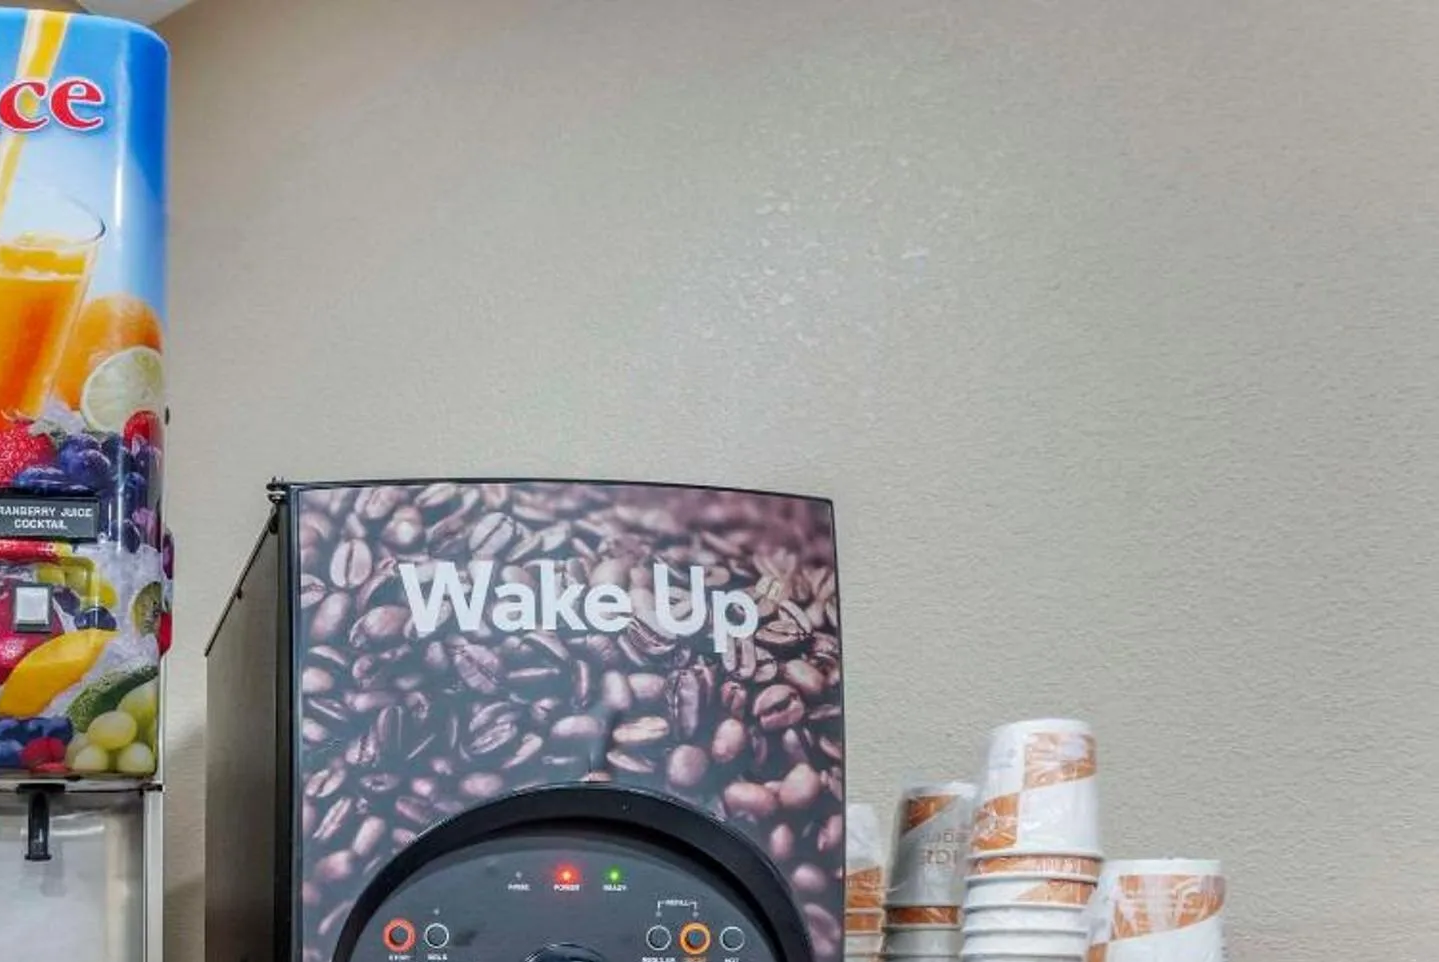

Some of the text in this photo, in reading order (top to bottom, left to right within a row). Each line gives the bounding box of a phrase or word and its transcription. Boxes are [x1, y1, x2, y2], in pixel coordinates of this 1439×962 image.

[60, 507, 93, 518] JUICE
[14, 519, 68, 531] COCKTAIL
[398, 560, 760, 653] Wake Up
